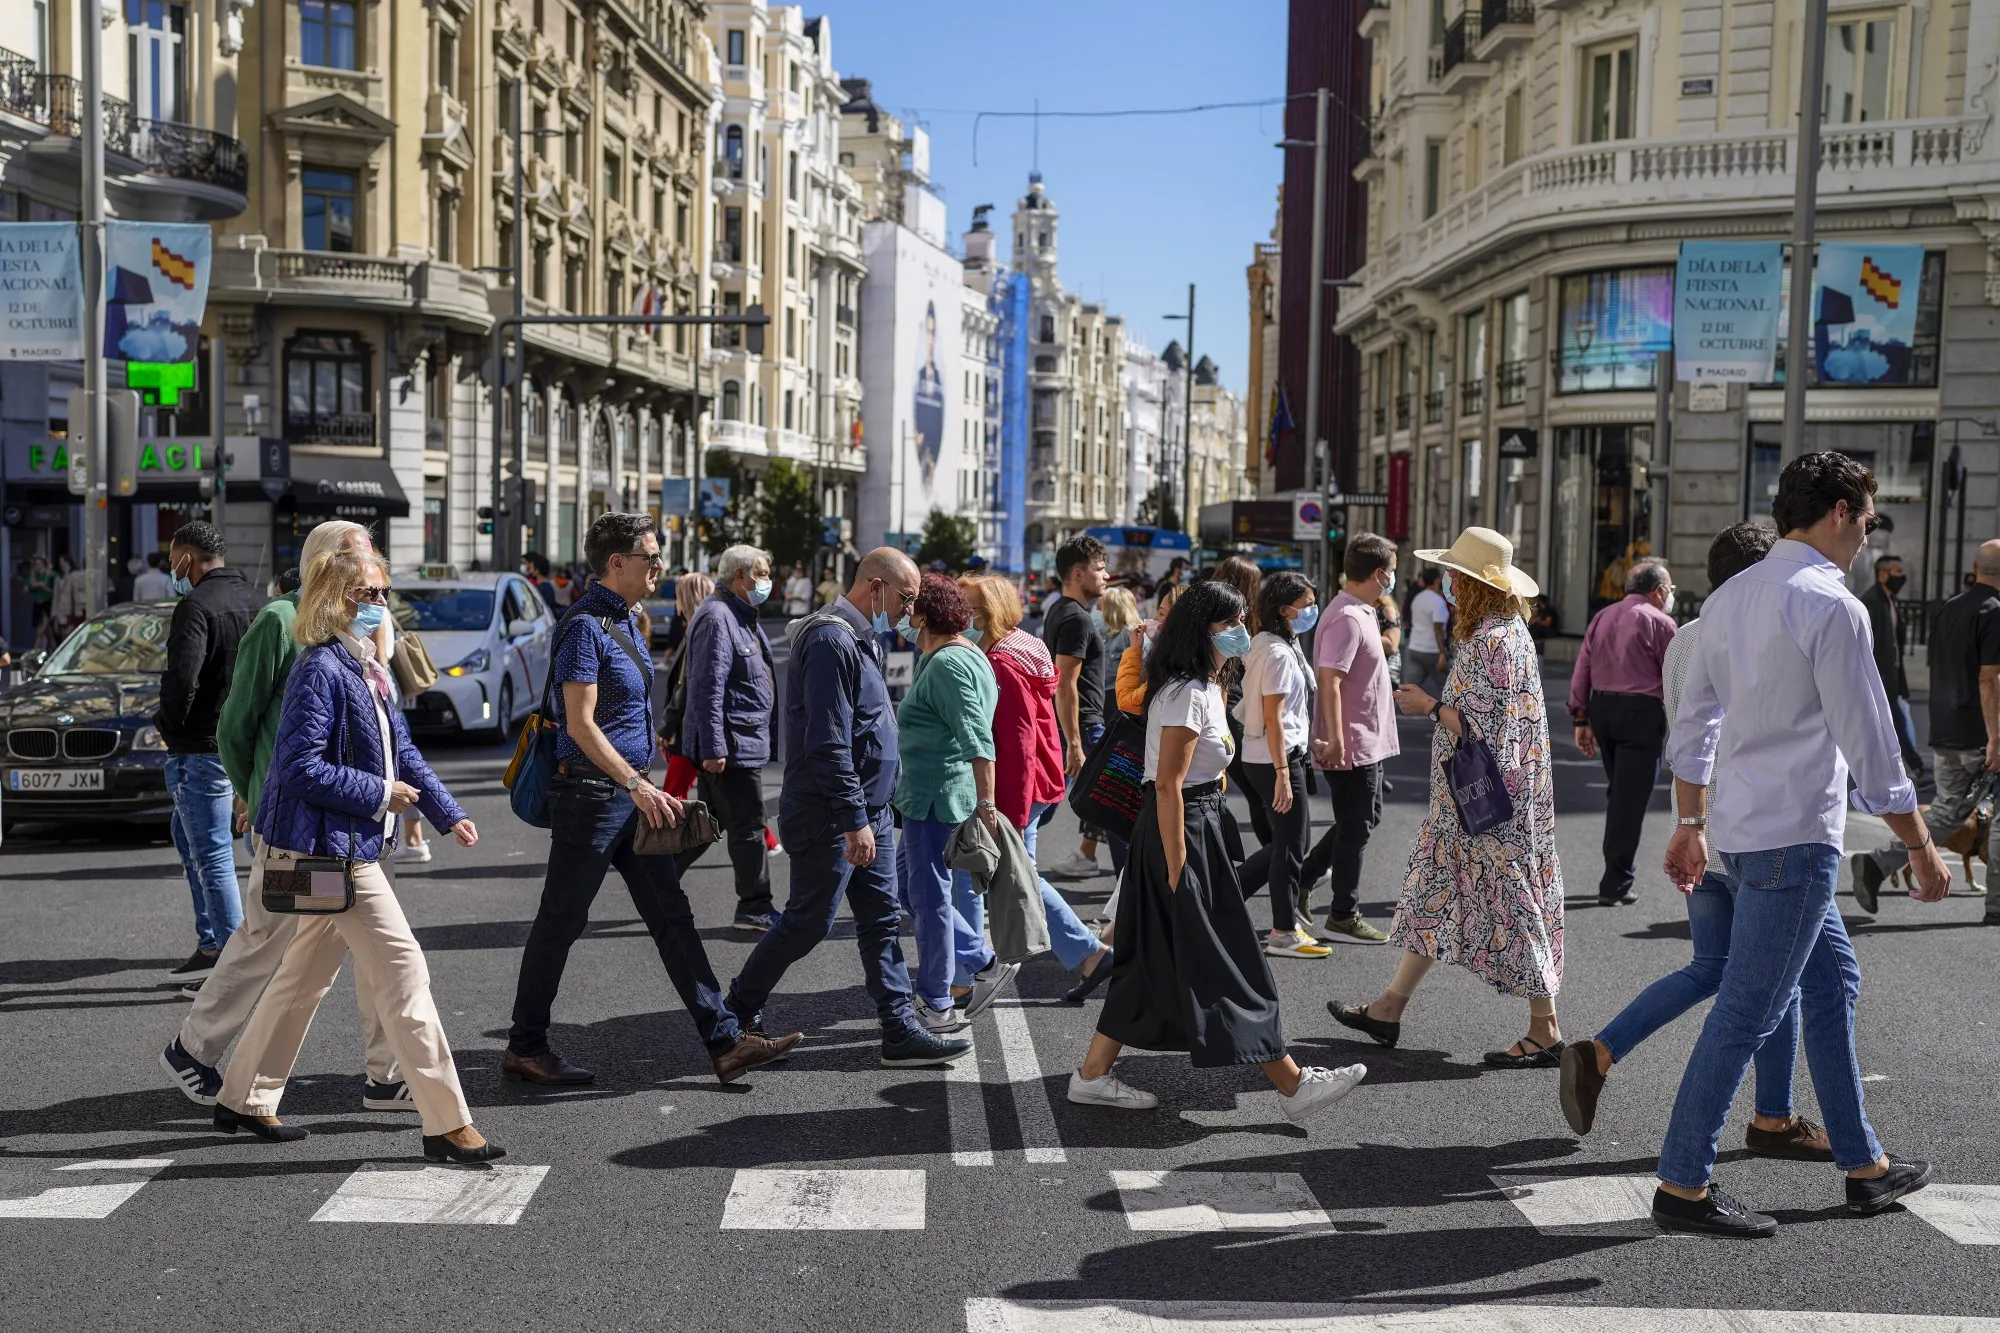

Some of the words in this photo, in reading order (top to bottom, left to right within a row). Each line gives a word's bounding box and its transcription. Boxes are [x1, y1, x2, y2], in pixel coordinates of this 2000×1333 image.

[19, 240, 42, 253] DE
[44, 240, 65, 253] LA
[1688, 257, 1717, 274] DÍA
[1720, 260, 1742, 273] DE
[1745, 260, 1768, 273] LA
[0, 277, 74, 291] ACIONAL
[1686, 279, 1739, 292] FIESTA
[9, 302, 20, 313] 12
[22, 302, 42, 314] DE
[1684, 298, 1771, 312] NACIONAL
[9, 317, 78, 330] OCTUBRE
[1701, 322, 1713, 334] 12
[1715, 322, 1735, 334] DE
[1699, 338, 1769, 351] OCTUBRE
[22, 347, 62, 357] MADRID
[1707, 368, 1747, 377] MADRID
[29, 444, 203, 471] FAACI
[335, 505, 377, 516] CASINO
[22, 773, 62, 788] 6077
[69, 772, 100, 788] JXM
